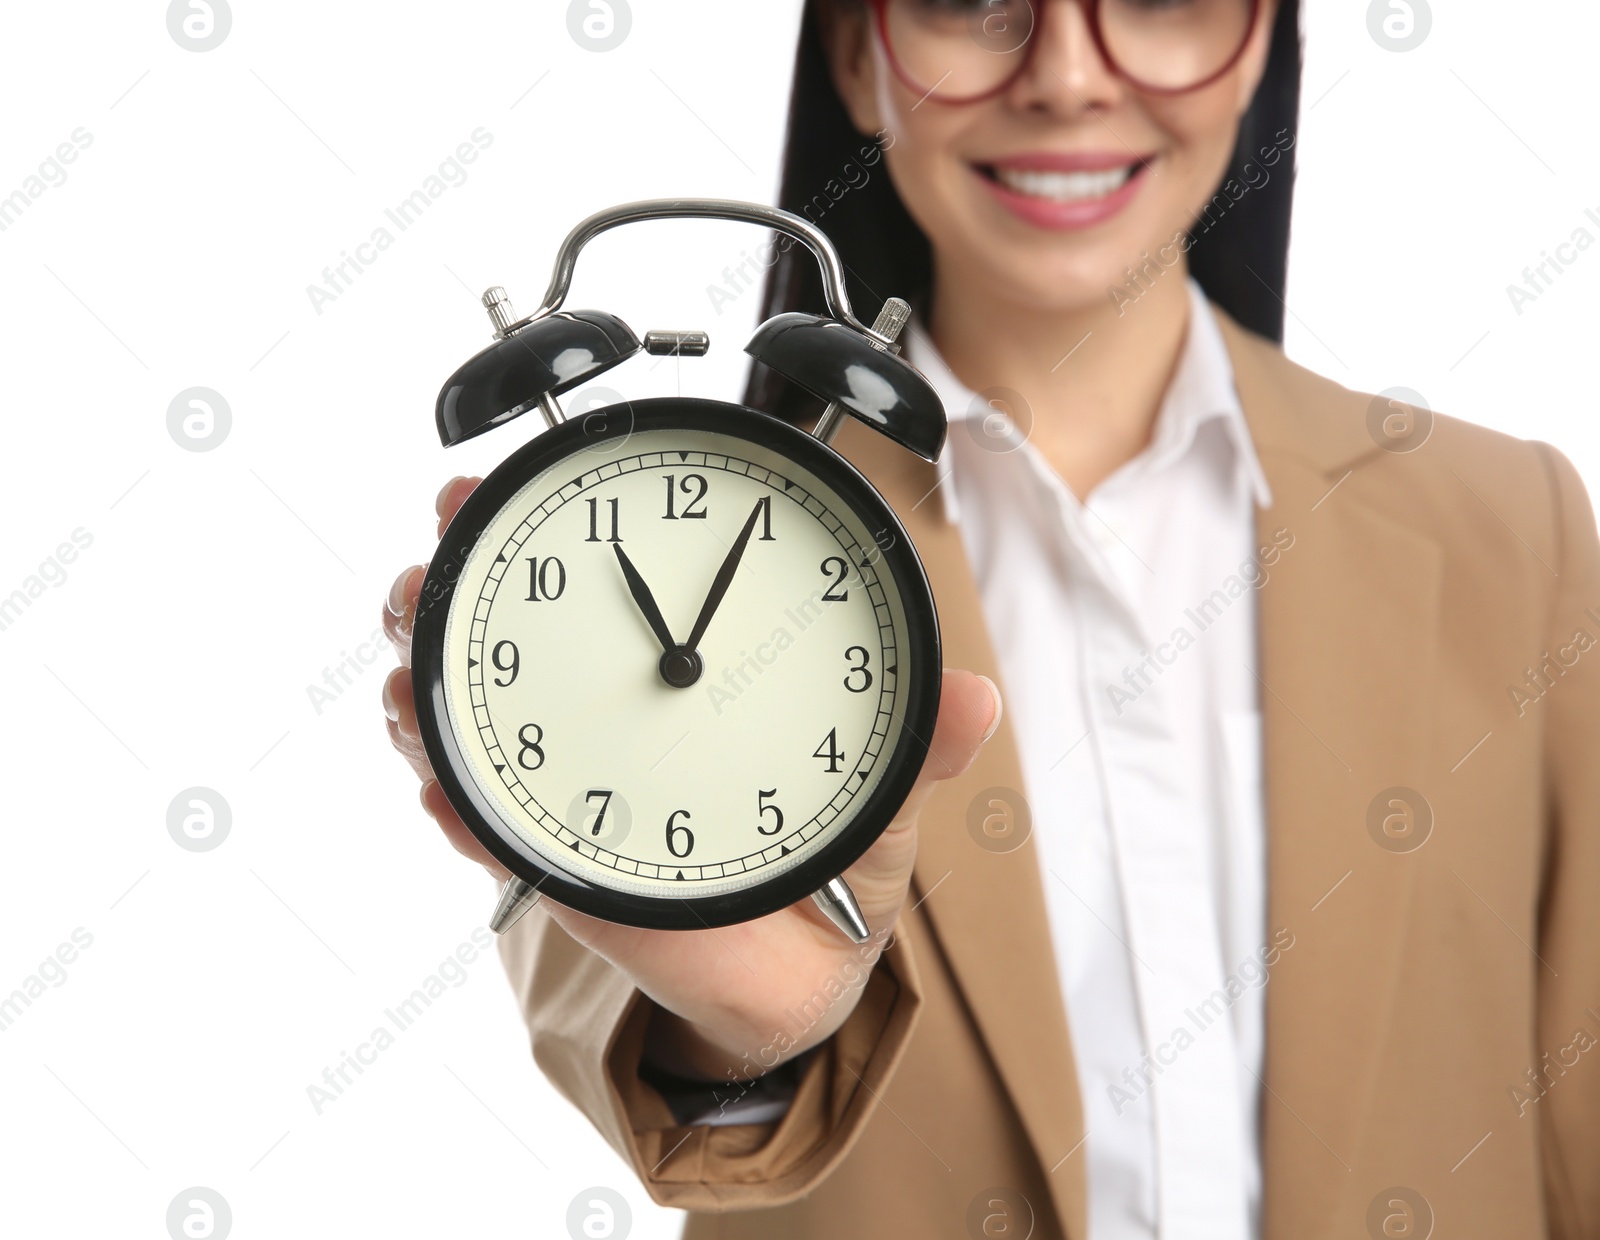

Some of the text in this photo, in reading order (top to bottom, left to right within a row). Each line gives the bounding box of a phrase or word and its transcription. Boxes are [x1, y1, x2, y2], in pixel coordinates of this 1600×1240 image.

[585, 497, 623, 542] 11
[662, 474, 708, 519] 12
[758, 495, 777, 541] 1
[525, 557, 566, 602] 10
[821, 557, 849, 602] 2
[492, 641, 520, 688] 9
[844, 646, 872, 693] 3
[518, 724, 545, 771] 8
[813, 727, 845, 773] 4
[585, 790, 613, 836] 7
[665, 810, 695, 858] 6
[757, 788, 784, 836] 5
